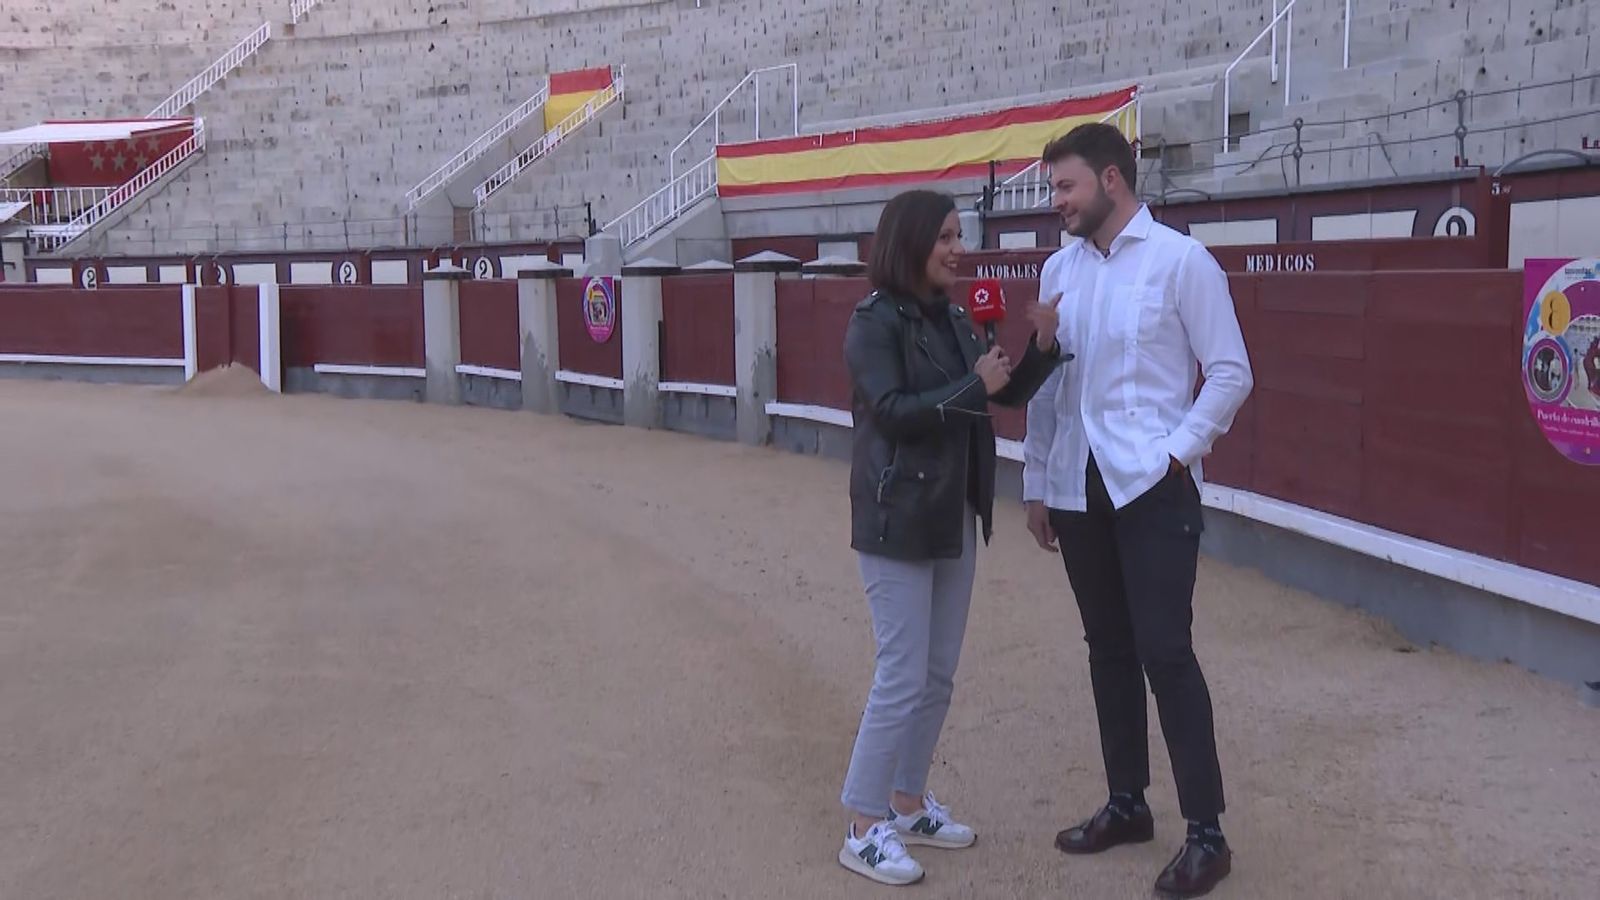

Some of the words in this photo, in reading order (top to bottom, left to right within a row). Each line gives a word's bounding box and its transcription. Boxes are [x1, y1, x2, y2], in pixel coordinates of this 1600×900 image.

[479, 260, 488, 280] 2
[976, 263, 1038, 279] MAYORALES
[1246, 253, 1314, 272] MEDICOS
[86, 269, 95, 288] 2
[343, 263, 352, 284] 2
